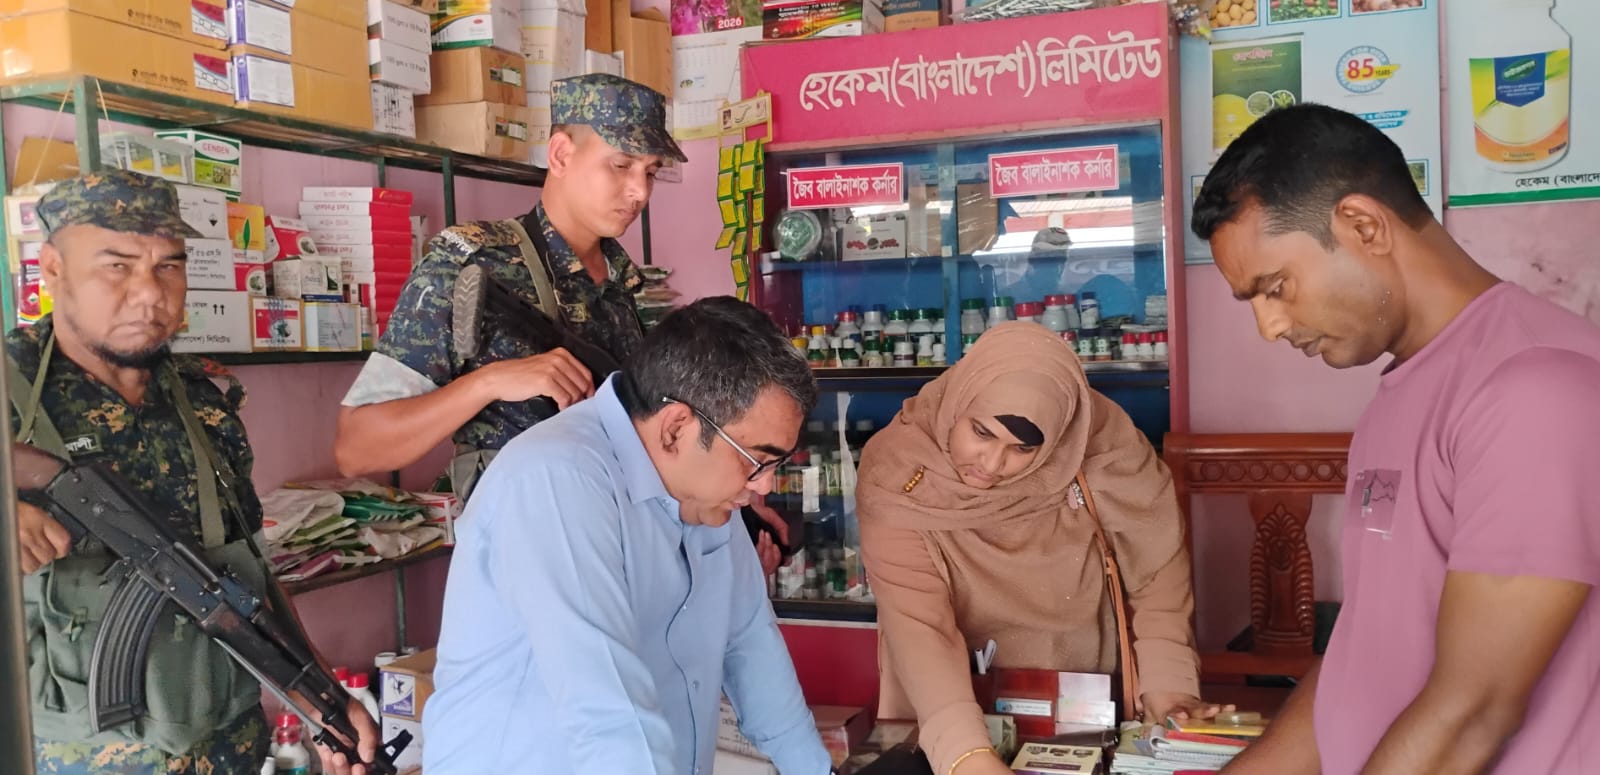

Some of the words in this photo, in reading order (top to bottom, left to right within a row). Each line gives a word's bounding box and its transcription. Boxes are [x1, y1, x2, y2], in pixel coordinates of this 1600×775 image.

[718, 17, 742, 29] 2026
[799, 65, 890, 111] হেকেম
[890, 40, 1037, 108] (বাংলাদেশ)
[1036, 31, 1162, 88] লিমিটেড
[1347, 58, 1375, 79] 85
[994, 161, 1019, 187] জৈব
[1021, 157, 1081, 183] বালাইনাশক
[1083, 152, 1113, 179] কর্নার
[1515, 176, 1550, 188] হেকেম
[792, 176, 814, 199] জৈব
[815, 172, 869, 198] বালাইনাশক
[871, 169, 898, 195] কর্নার
